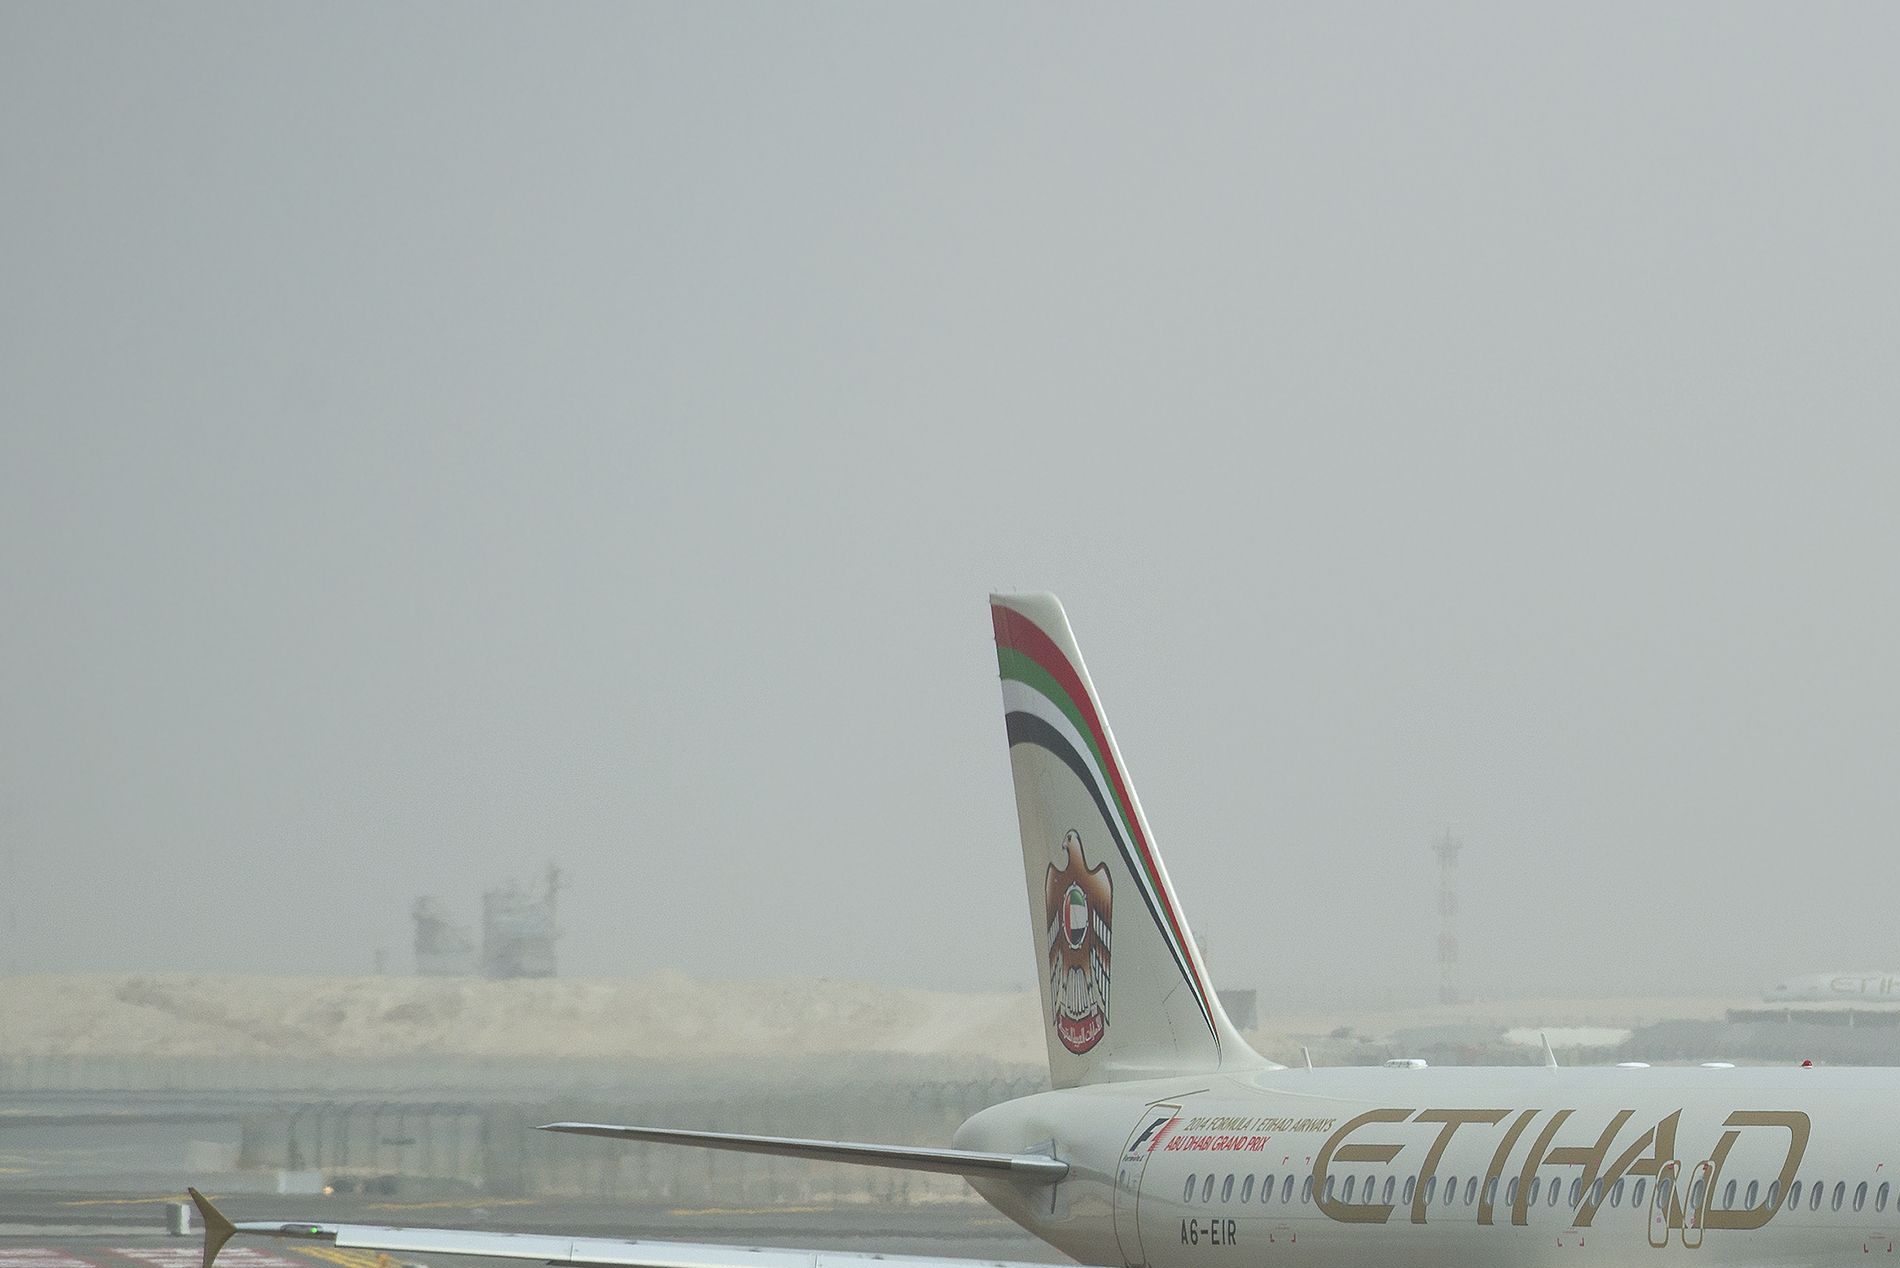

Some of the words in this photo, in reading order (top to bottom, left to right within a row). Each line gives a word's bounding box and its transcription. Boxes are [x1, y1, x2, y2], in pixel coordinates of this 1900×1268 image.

[1184, 1117, 1210, 1131] 2014
[1207, 1117, 1249, 1131] FORMULA
[1256, 1118, 1293, 1132] ETIHAD
[1290, 1118, 1336, 1133] AIRWAYS
[1164, 1135, 1188, 1151] ABU
[1183, 1136, 1214, 1151] DHABI
[1211, 1136, 1248, 1151] GRAND
[1244, 1136, 1271, 1151] PRIX
[1312, 1108, 1811, 1229] ETIHAD
[1181, 1219, 1237, 1246] A6-EIR
